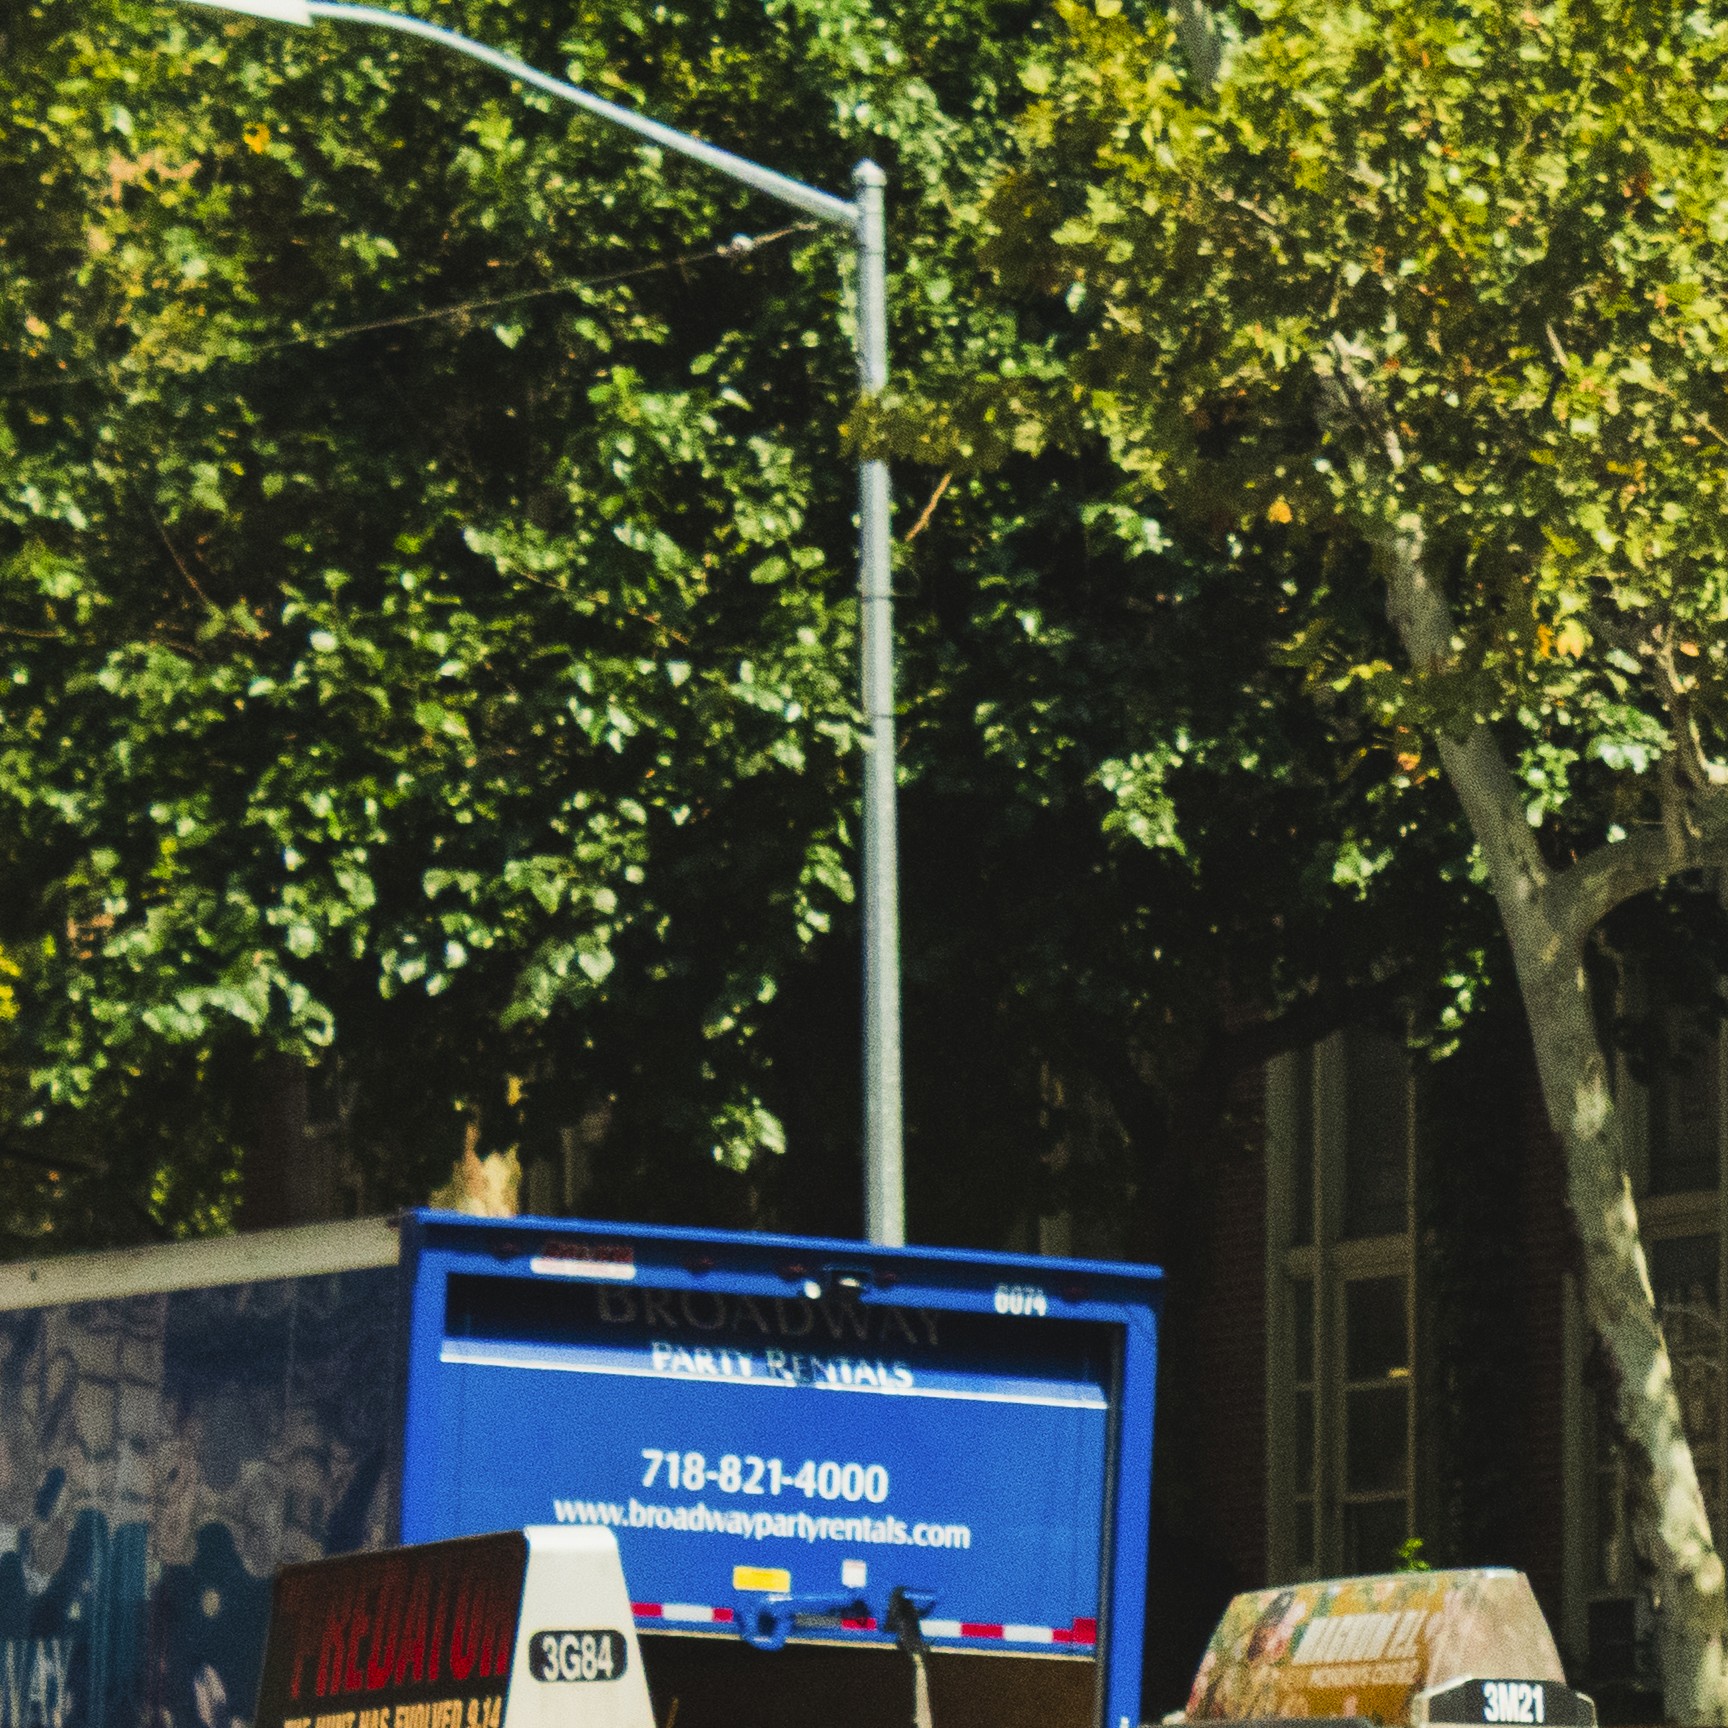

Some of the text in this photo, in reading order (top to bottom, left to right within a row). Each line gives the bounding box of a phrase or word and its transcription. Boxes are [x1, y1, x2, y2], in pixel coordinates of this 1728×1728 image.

[652, 1341, 914, 1389] PARTY RENTALS
[641, 1448, 890, 1503] 718-821-4000
[553, 1497, 972, 1549] www.broadwaypartyrentals.com
[541, 1634, 614, 1682] 3G84
[1482, 1681, 1545, 1725] 3M21
